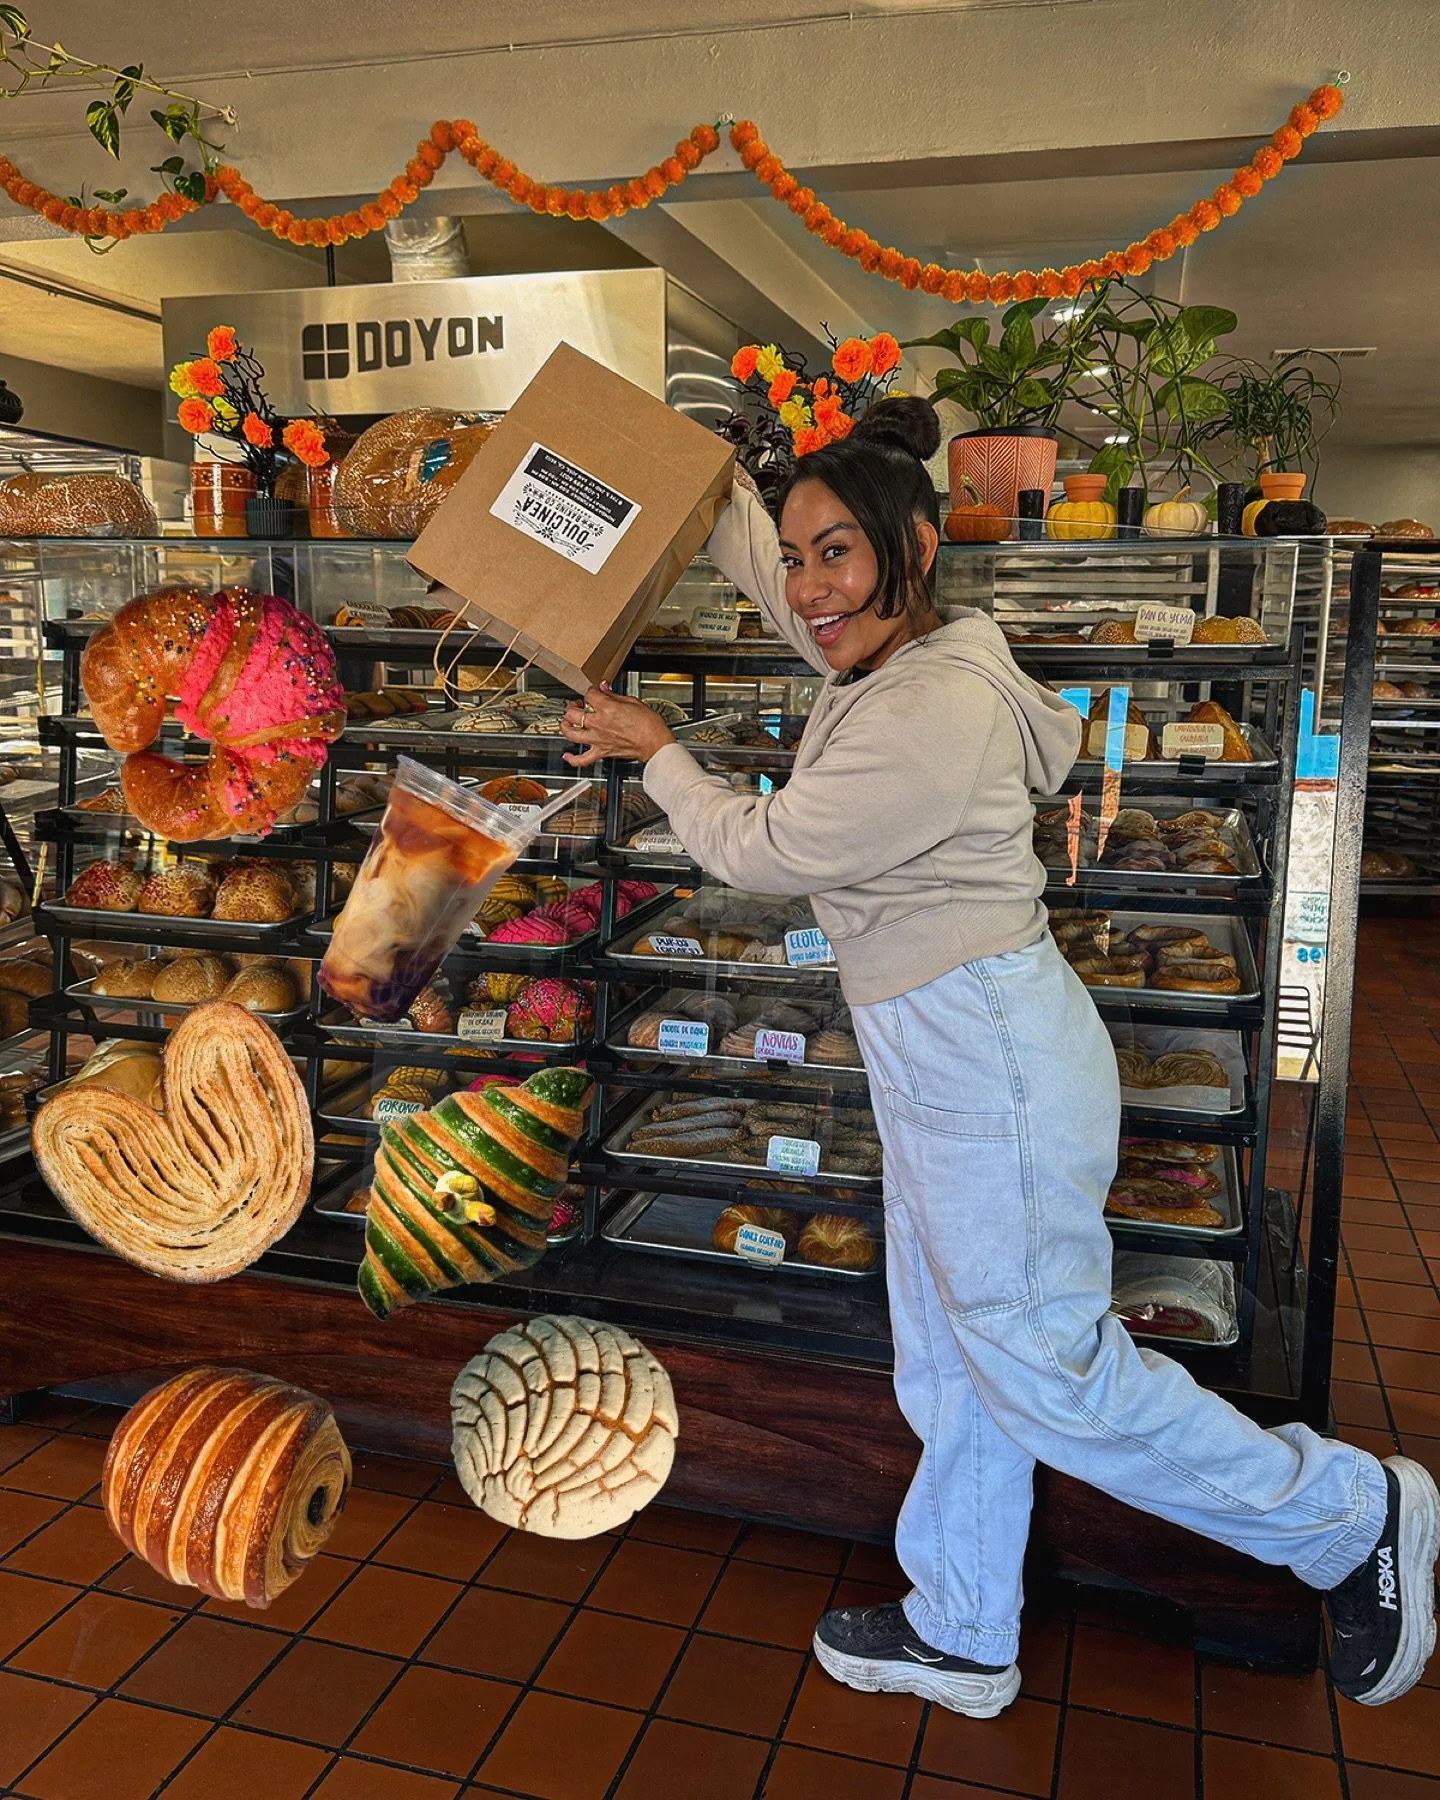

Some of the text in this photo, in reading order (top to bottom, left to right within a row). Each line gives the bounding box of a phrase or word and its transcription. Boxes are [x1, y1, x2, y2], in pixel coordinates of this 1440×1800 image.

[356, 315, 504, 372] DOYON
[519, 495, 591, 545] DULCINEA
[553, 501, 582, 522] BAKING
[1140, 608, 1156, 621] PAN
[1157, 611, 1166, 622] DE
[761, 1032, 799, 1051] NOVIAS
[378, 1099, 420, 1114] CORONA
[1377, 1546, 1398, 1611] HOKA
